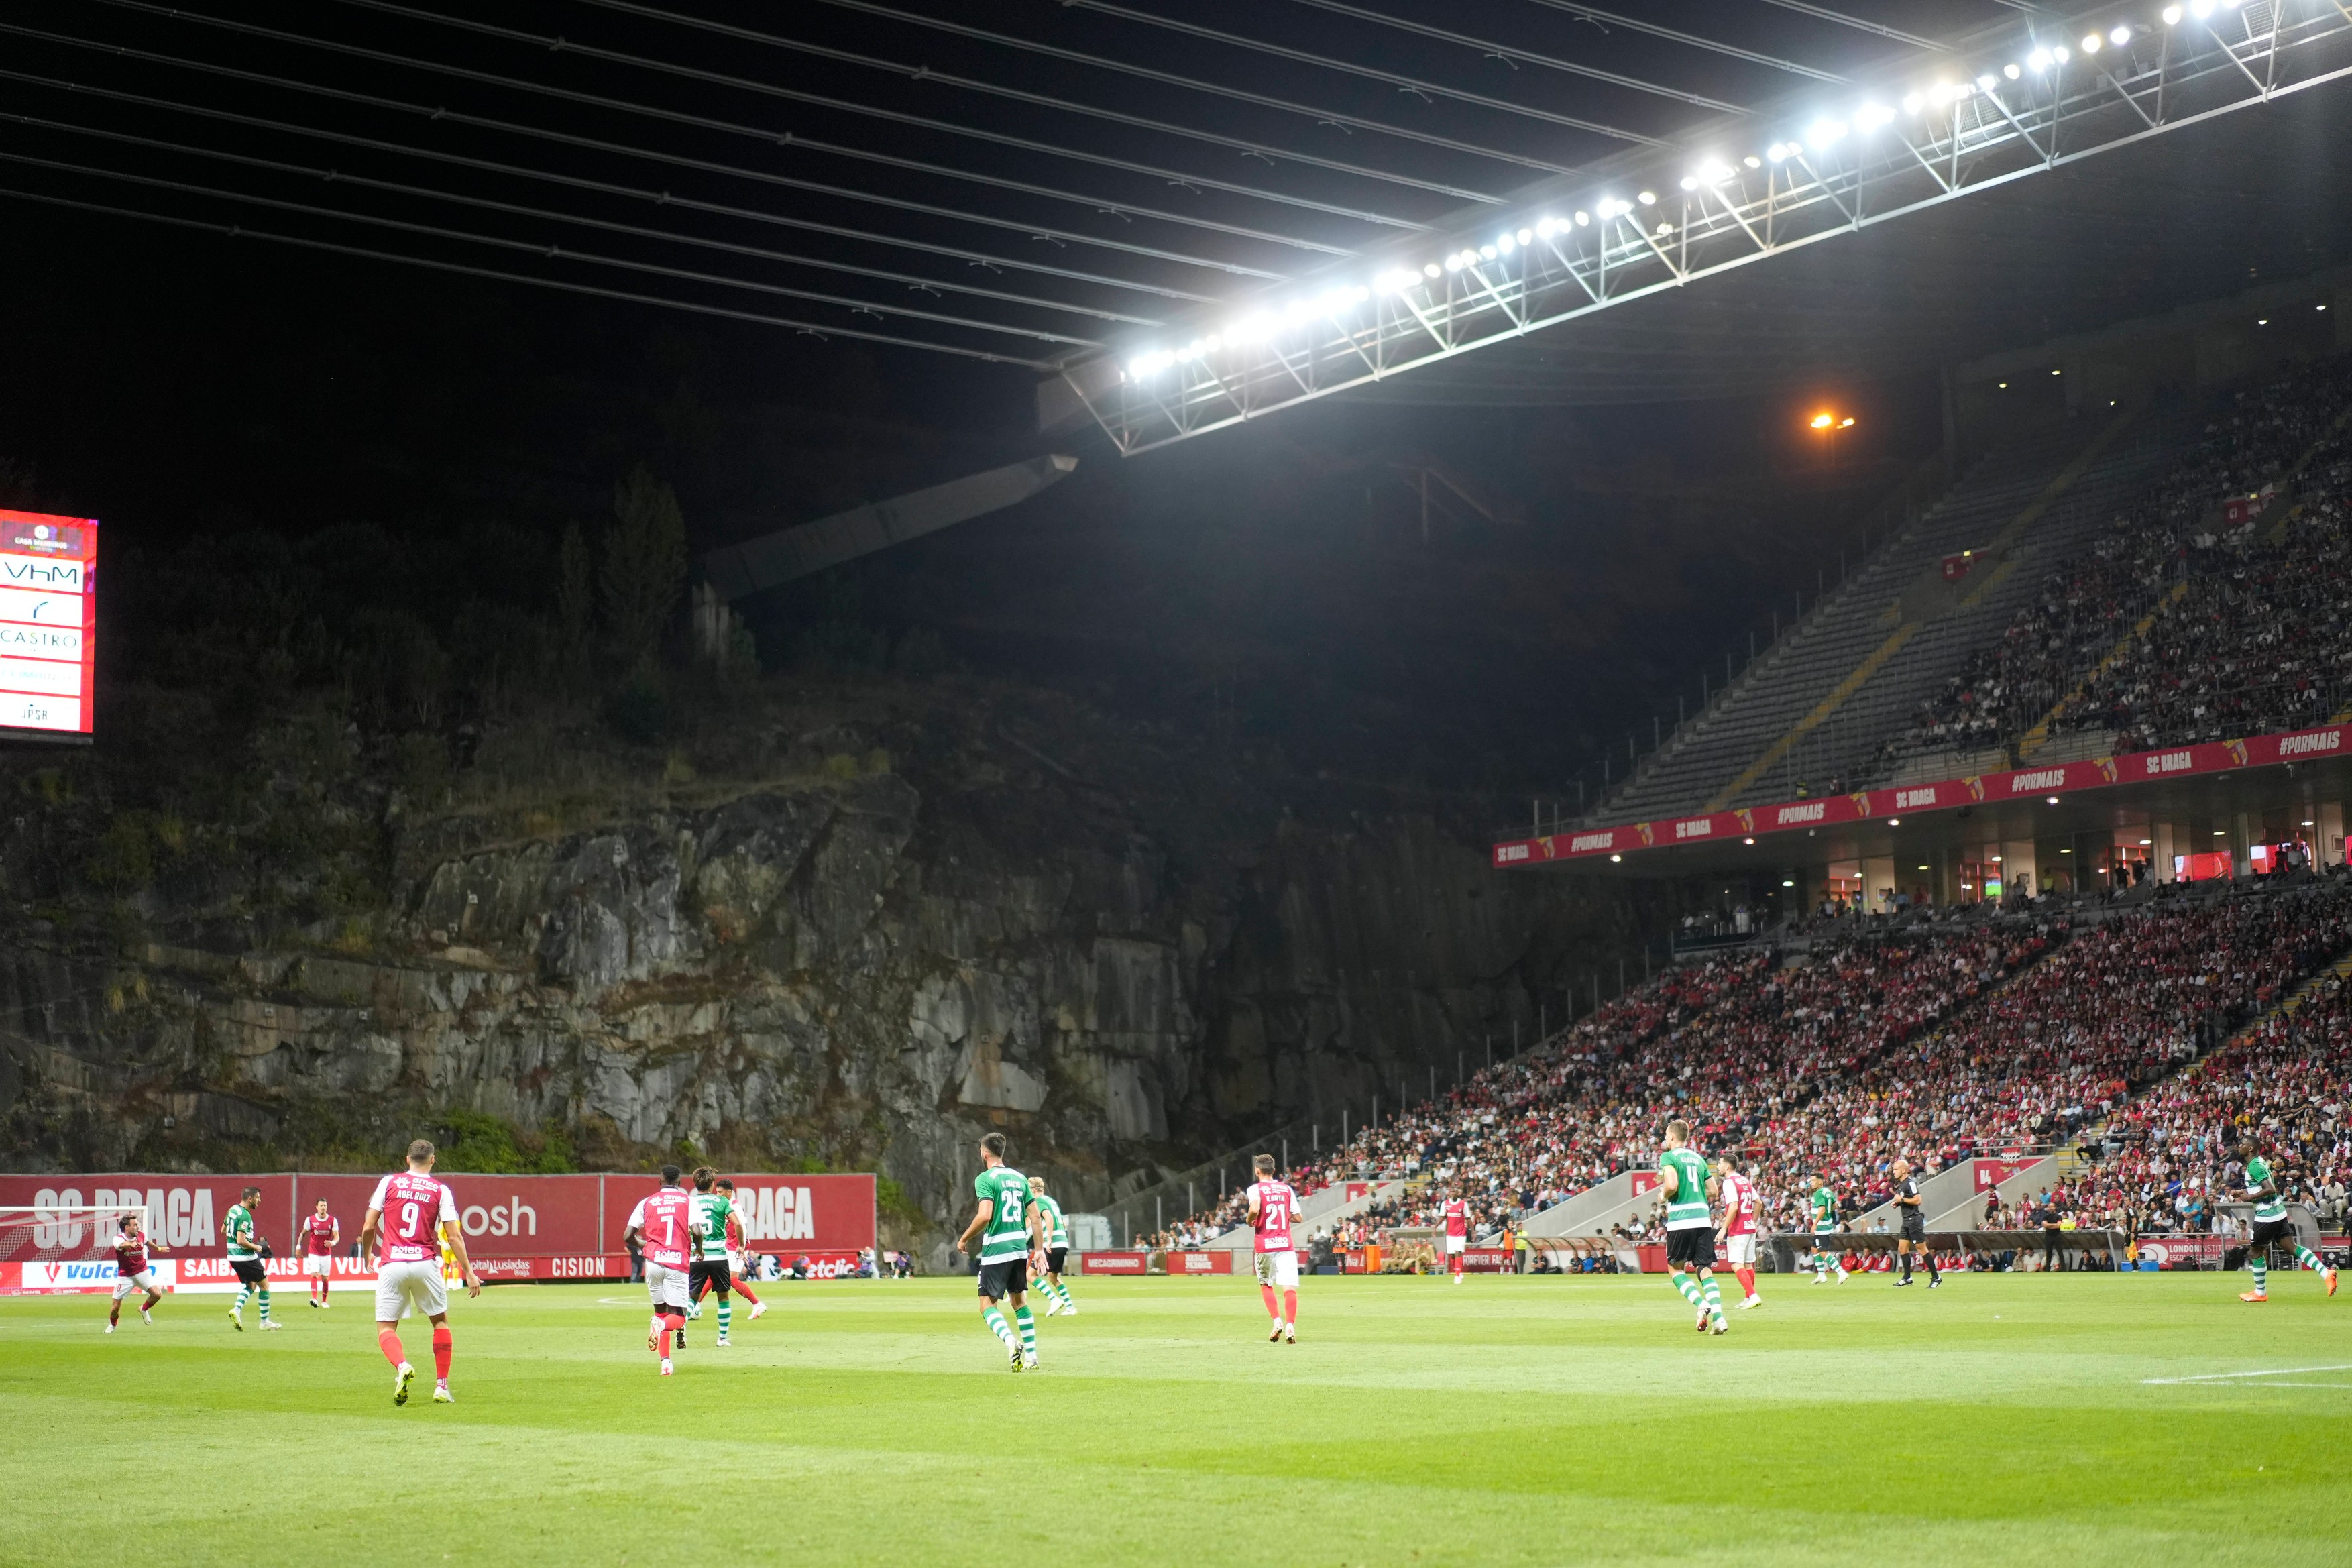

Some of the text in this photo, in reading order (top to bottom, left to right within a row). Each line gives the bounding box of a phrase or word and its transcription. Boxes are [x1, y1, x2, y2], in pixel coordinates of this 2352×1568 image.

[2279, 730, 2340, 756] #PORMAIS
[2147, 751, 2192, 773] SC BRAGA
[2012, 769, 2065, 793] #PORMAIS
[1896, 788, 1936, 809] SC BRAGA
[1777, 803, 1825, 825] #PORMAIS
[1687, 819, 1712, 837] BRAGA
[1507, 844, 1529, 861] BRAGA
[1571, 833, 1613, 852] #PORMAIS
[412, 1178, 439, 1190] amco
[1686, 1165, 1699, 1192] 4
[396, 1190, 431, 1203] ABEL RUIZ
[1001, 1190, 1023, 1222] 25
[34, 1188, 83, 1249] SC
[399, 1202, 419, 1238] 9
[461, 1196, 537, 1236] osh
[732, 1186, 814, 1240] RAGA
[1265, 1203, 1286, 1230] 21
[660, 1215, 674, 1246] 7
[391, 1245, 423, 1254] soleo
[1264, 1237, 1288, 1245] soleo
[2169, 1245, 2199, 1253] LONDON
[654, 1249, 682, 1259] soleo
[1088, 1258, 1139, 1268] MECAGRIMINHO
[68, 1263, 156, 1279] Vulc
[552, 1257, 605, 1277] CISION
[805, 1258, 856, 1278] etclic
